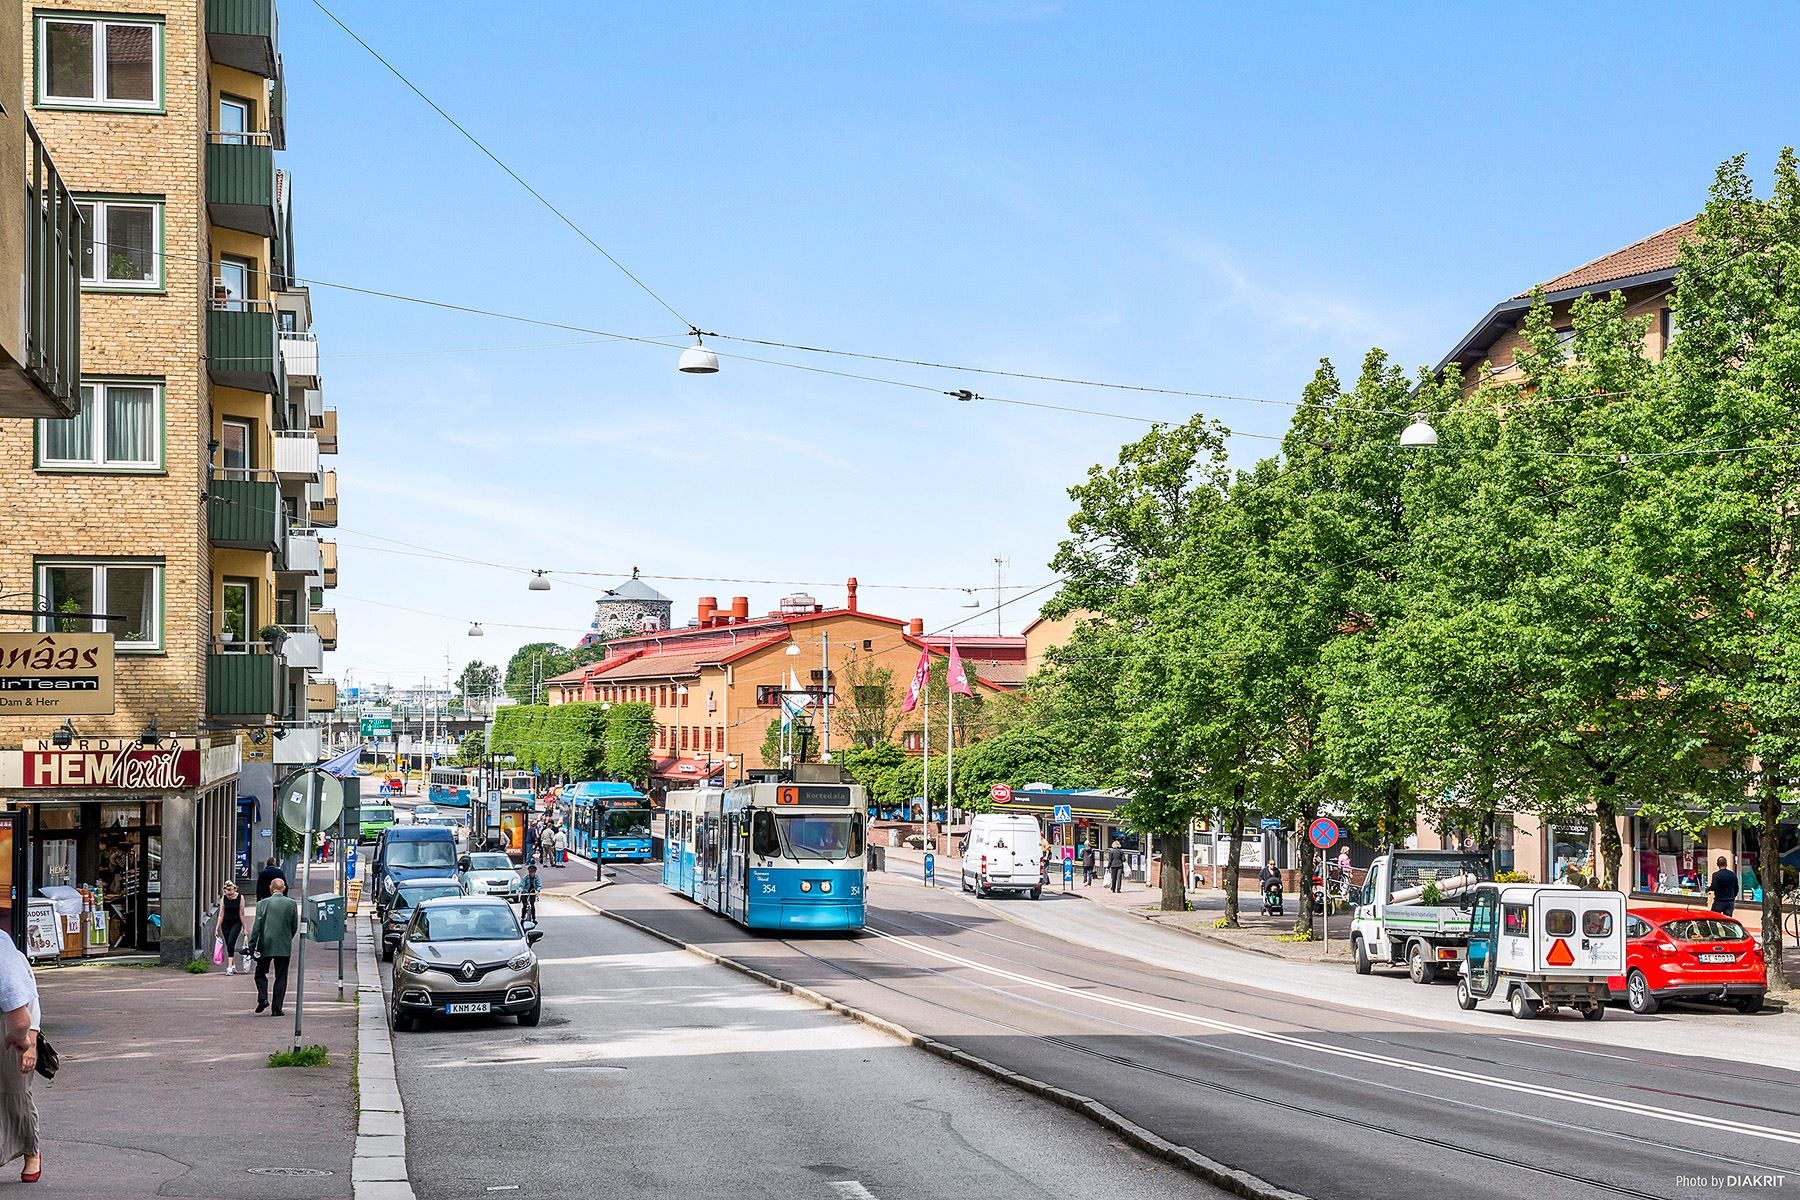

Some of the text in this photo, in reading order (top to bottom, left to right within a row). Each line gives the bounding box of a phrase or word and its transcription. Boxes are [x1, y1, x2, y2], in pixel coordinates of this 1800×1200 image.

[0, 698, 60, 706] Dam & Herr
[491, 792, 497, 801] B
[783, 788, 846, 803] 6 Kortedala
[762, 884, 776, 893] 354
[851, 886, 860, 896] 354
[452, 1003, 487, 1012] KNM 248
